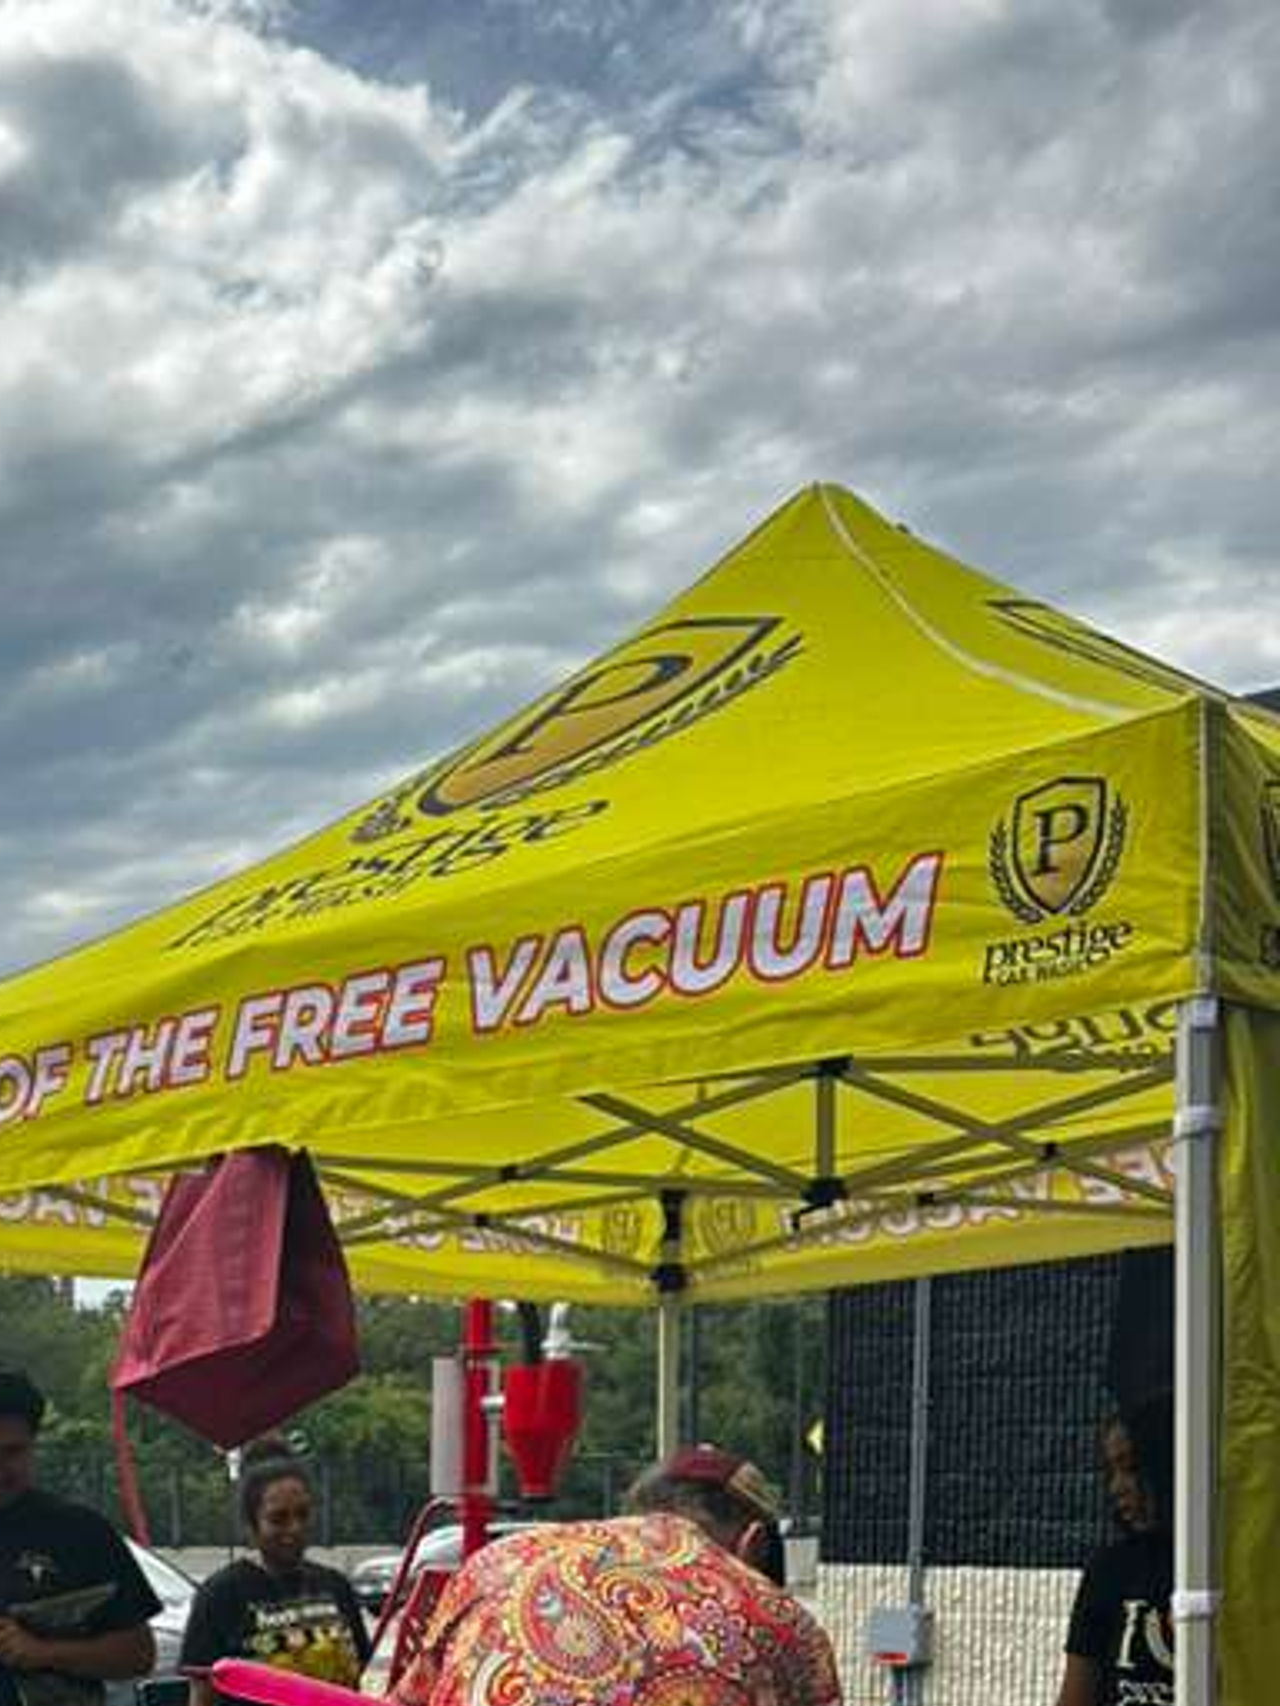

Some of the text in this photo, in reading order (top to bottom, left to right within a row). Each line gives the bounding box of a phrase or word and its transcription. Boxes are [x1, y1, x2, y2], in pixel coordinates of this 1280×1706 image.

[1032, 803, 1089, 876] P
[84, 1003, 220, 1105] THE
[225, 956, 447, 1081] FREE
[466, 850, 944, 1033] VACUUM
[983, 920, 1134, 985] prestige
